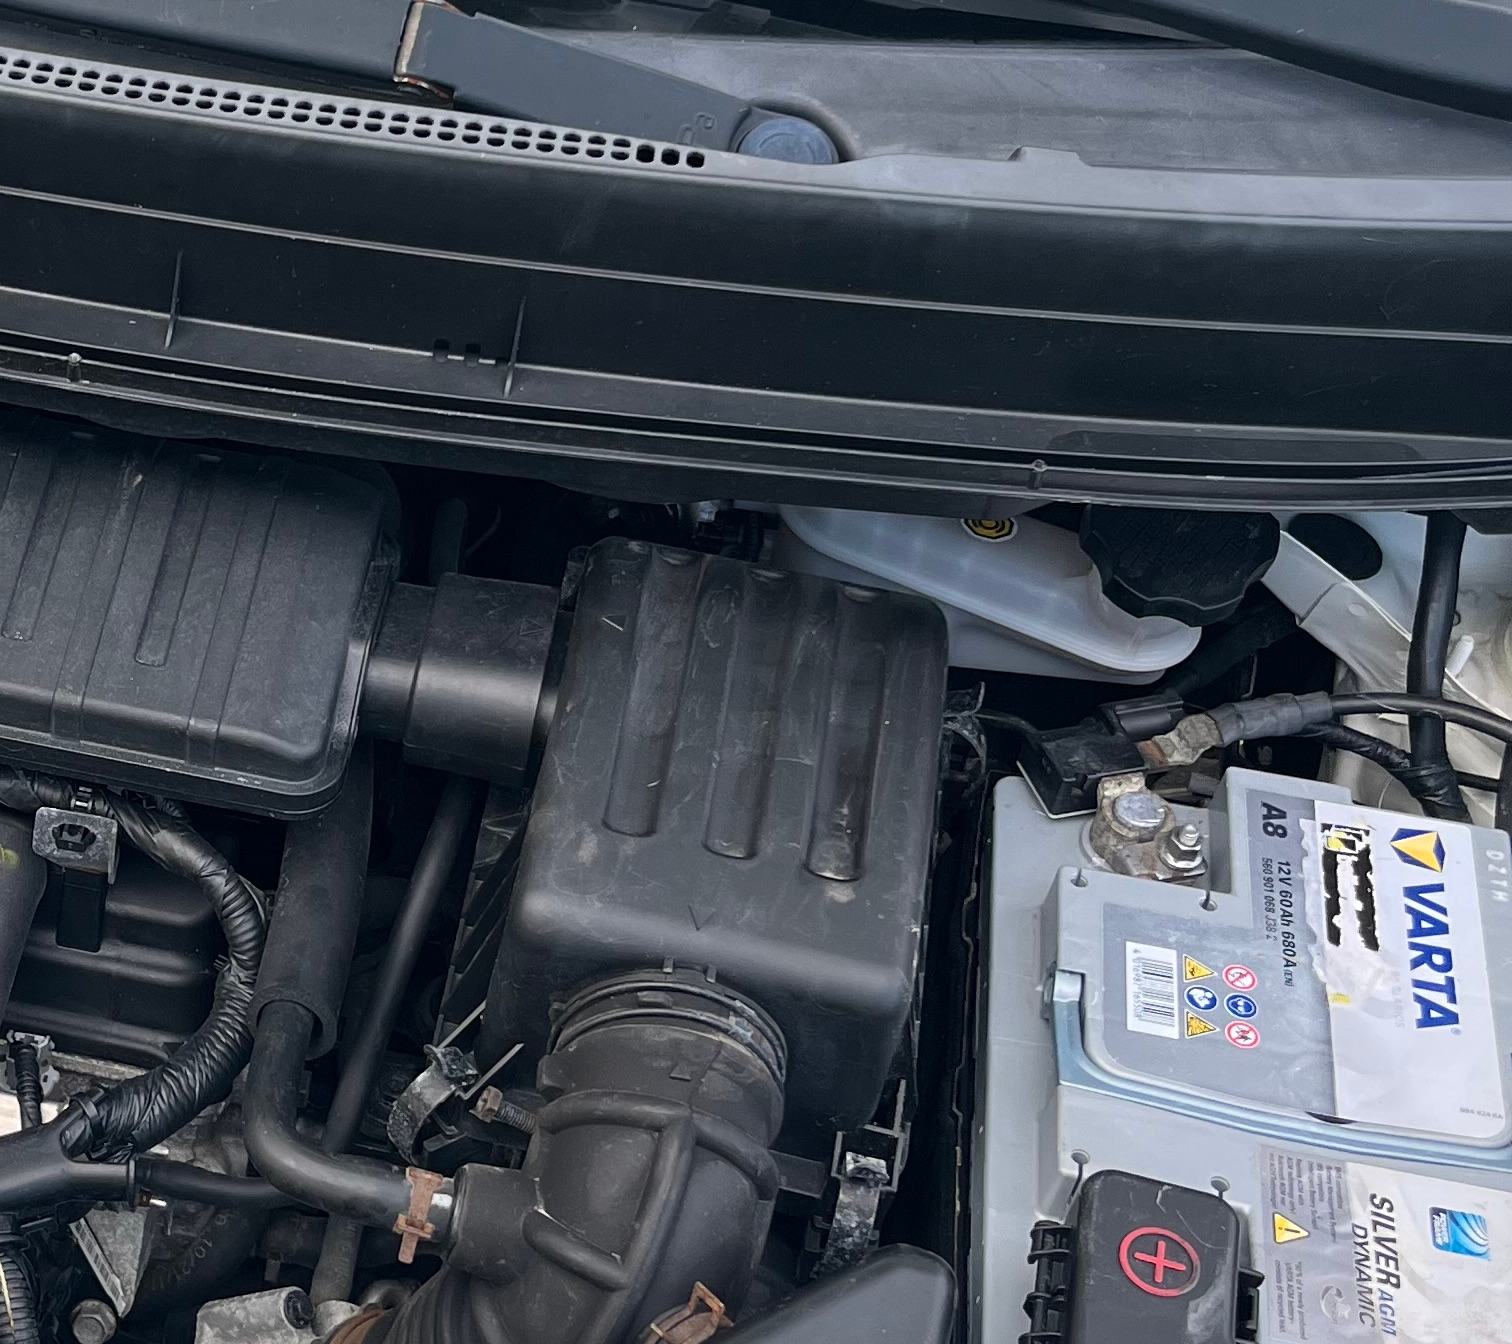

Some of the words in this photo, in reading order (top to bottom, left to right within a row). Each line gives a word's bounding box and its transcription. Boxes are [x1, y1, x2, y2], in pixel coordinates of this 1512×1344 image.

[1261, 801, 1287, 838] A8
[1262, 857, 1273, 874] 560
[1277, 861, 1292, 886] 12V
[1264, 877, 1274, 892] 901
[1265, 895, 1275, 913] 068
[1404, 882, 1459, 1030] VARTA
[1370, 1193, 1400, 1288] SILVER
[1351, 1223, 1376, 1328] DYNAMIC
[1377, 1288, 1397, 1336] AGM
